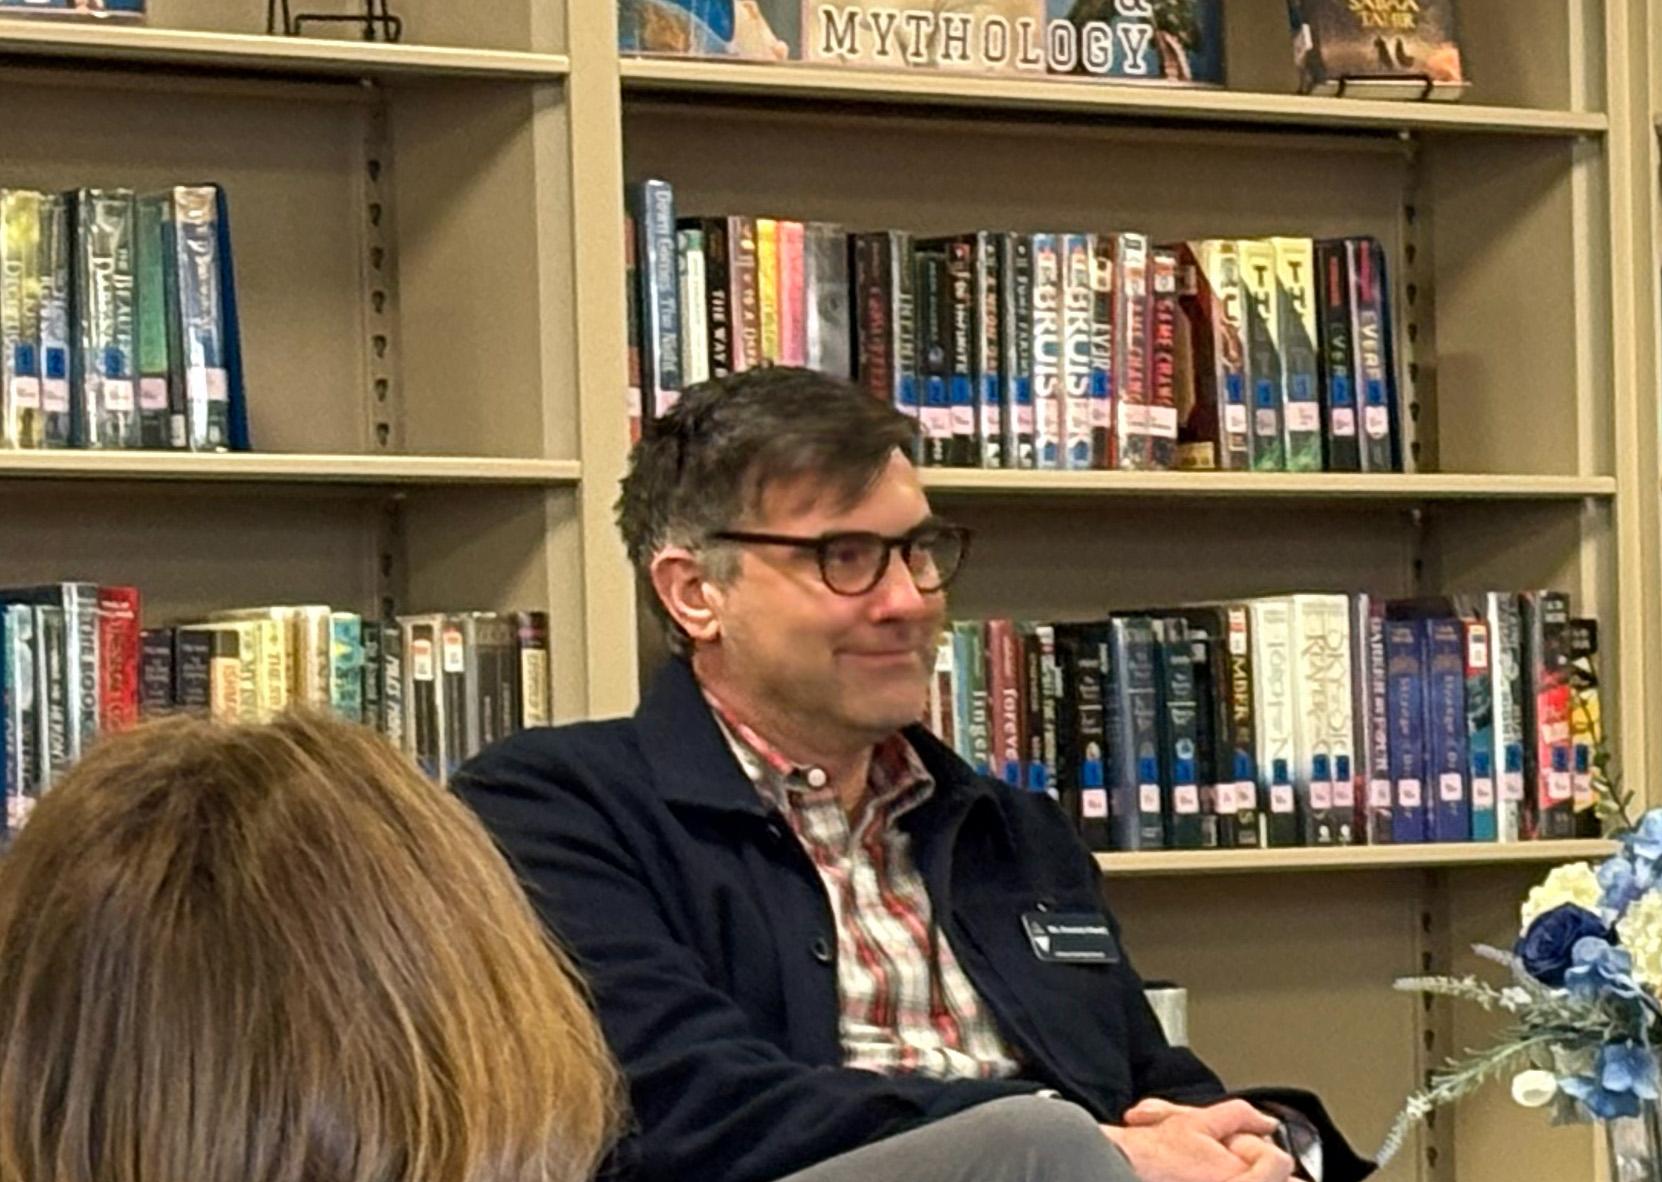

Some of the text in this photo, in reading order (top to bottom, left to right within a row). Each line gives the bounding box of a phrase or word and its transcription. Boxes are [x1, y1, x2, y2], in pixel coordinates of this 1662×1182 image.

[819, 5, 1153, 74] MYTHOLOGY
[968, 689, 988, 762] linger
[1003, 688, 1018, 761] foreve
